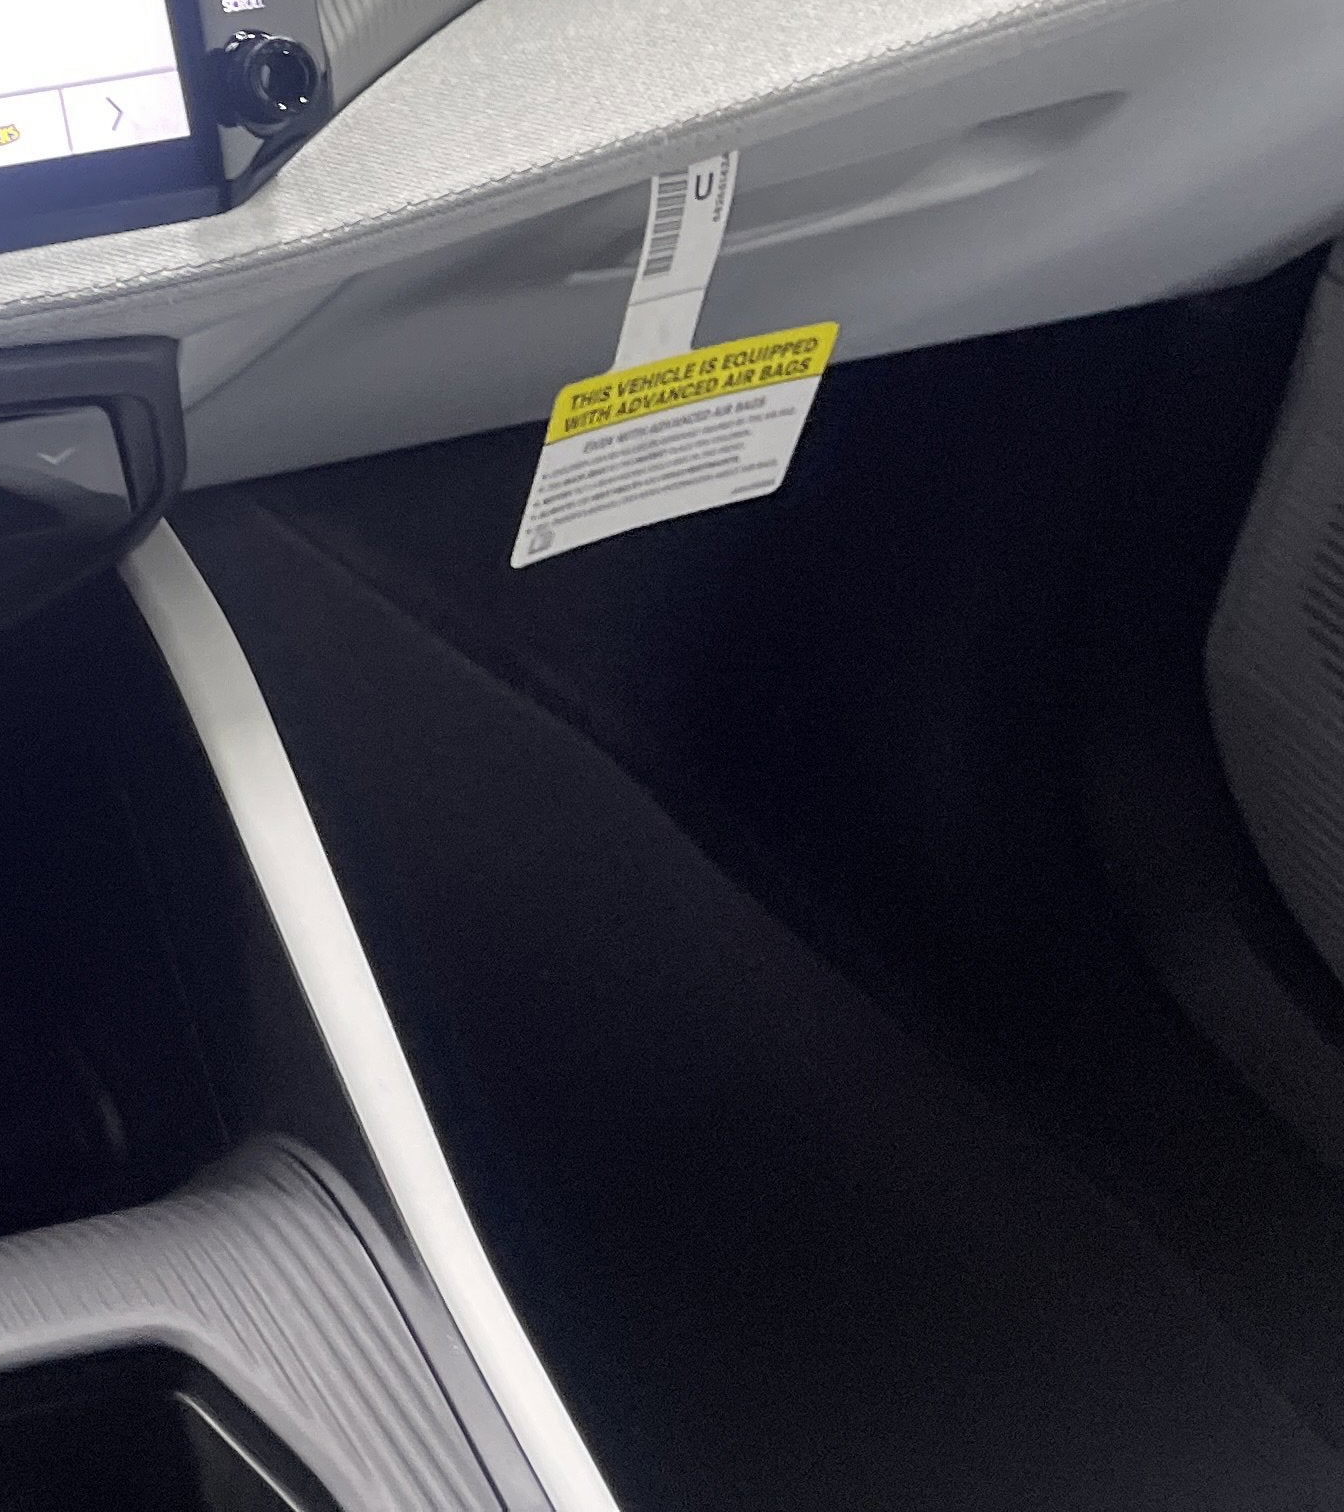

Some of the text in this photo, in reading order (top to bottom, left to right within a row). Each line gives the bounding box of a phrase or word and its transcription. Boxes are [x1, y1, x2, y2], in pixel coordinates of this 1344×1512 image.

[694, 173, 713, 200] U
[564, 357, 812, 433] WITH ADVANCED AIR BAGS
[570, 337, 819, 410] THIS VEHICLE IS EQUIPPED
